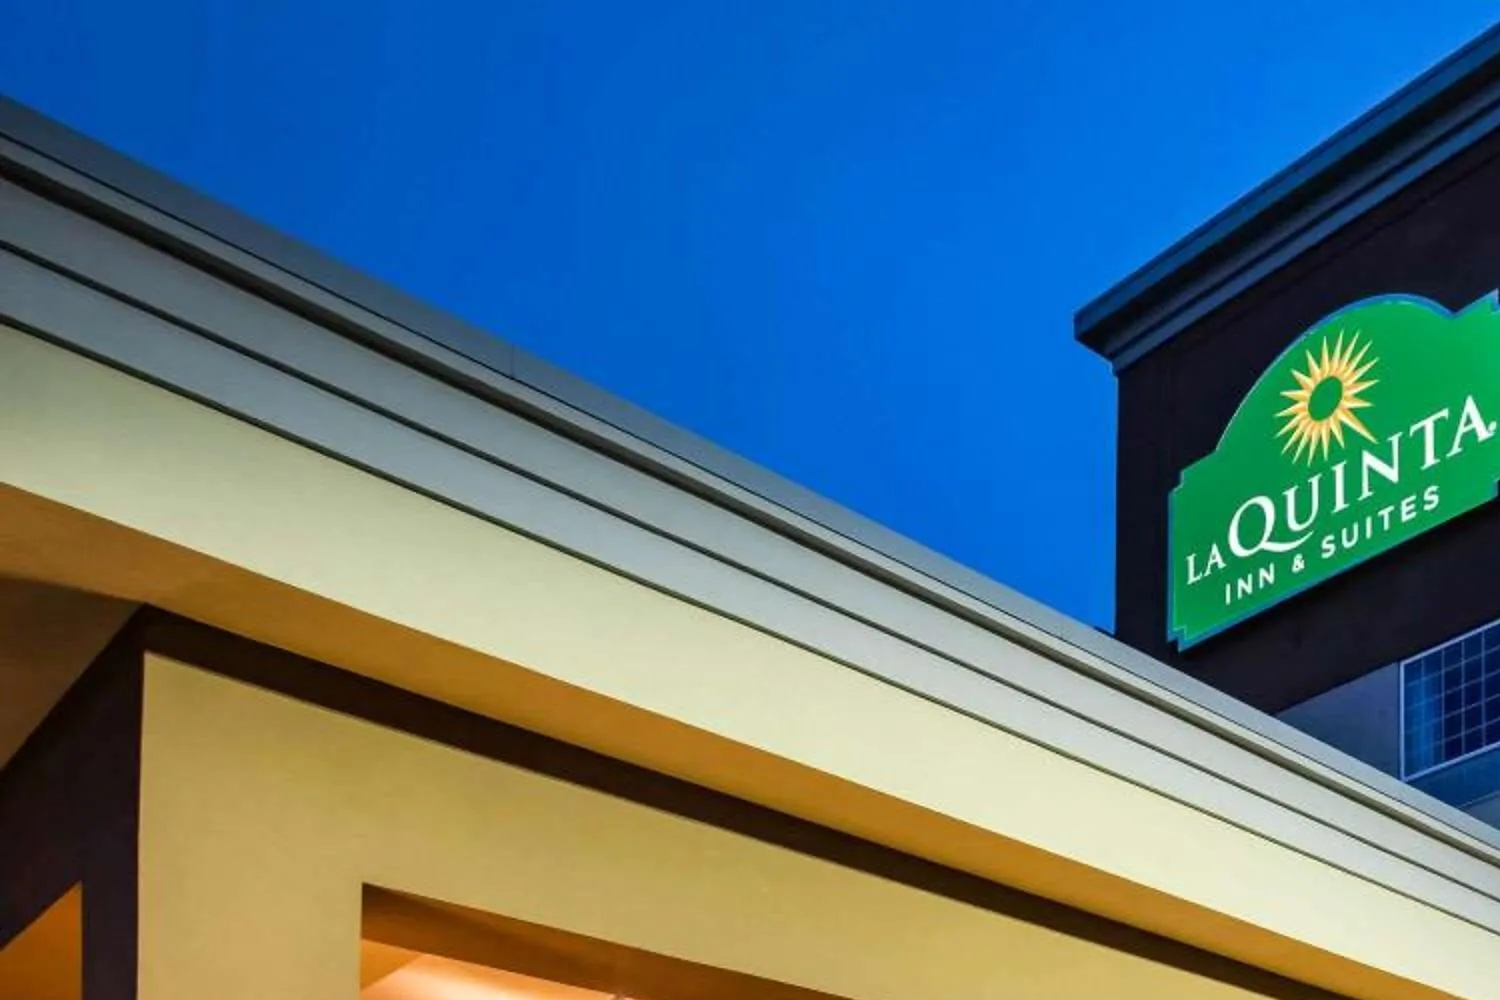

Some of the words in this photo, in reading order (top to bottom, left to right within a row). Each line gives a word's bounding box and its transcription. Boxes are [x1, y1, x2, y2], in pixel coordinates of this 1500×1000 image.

[1186, 543, 1227, 585] LA
[1227, 394, 1497, 557] QUINTA
[1225, 563, 1276, 606] INN
[1291, 553, 1306, 574] &
[1320, 484, 1440, 560] SUITES
